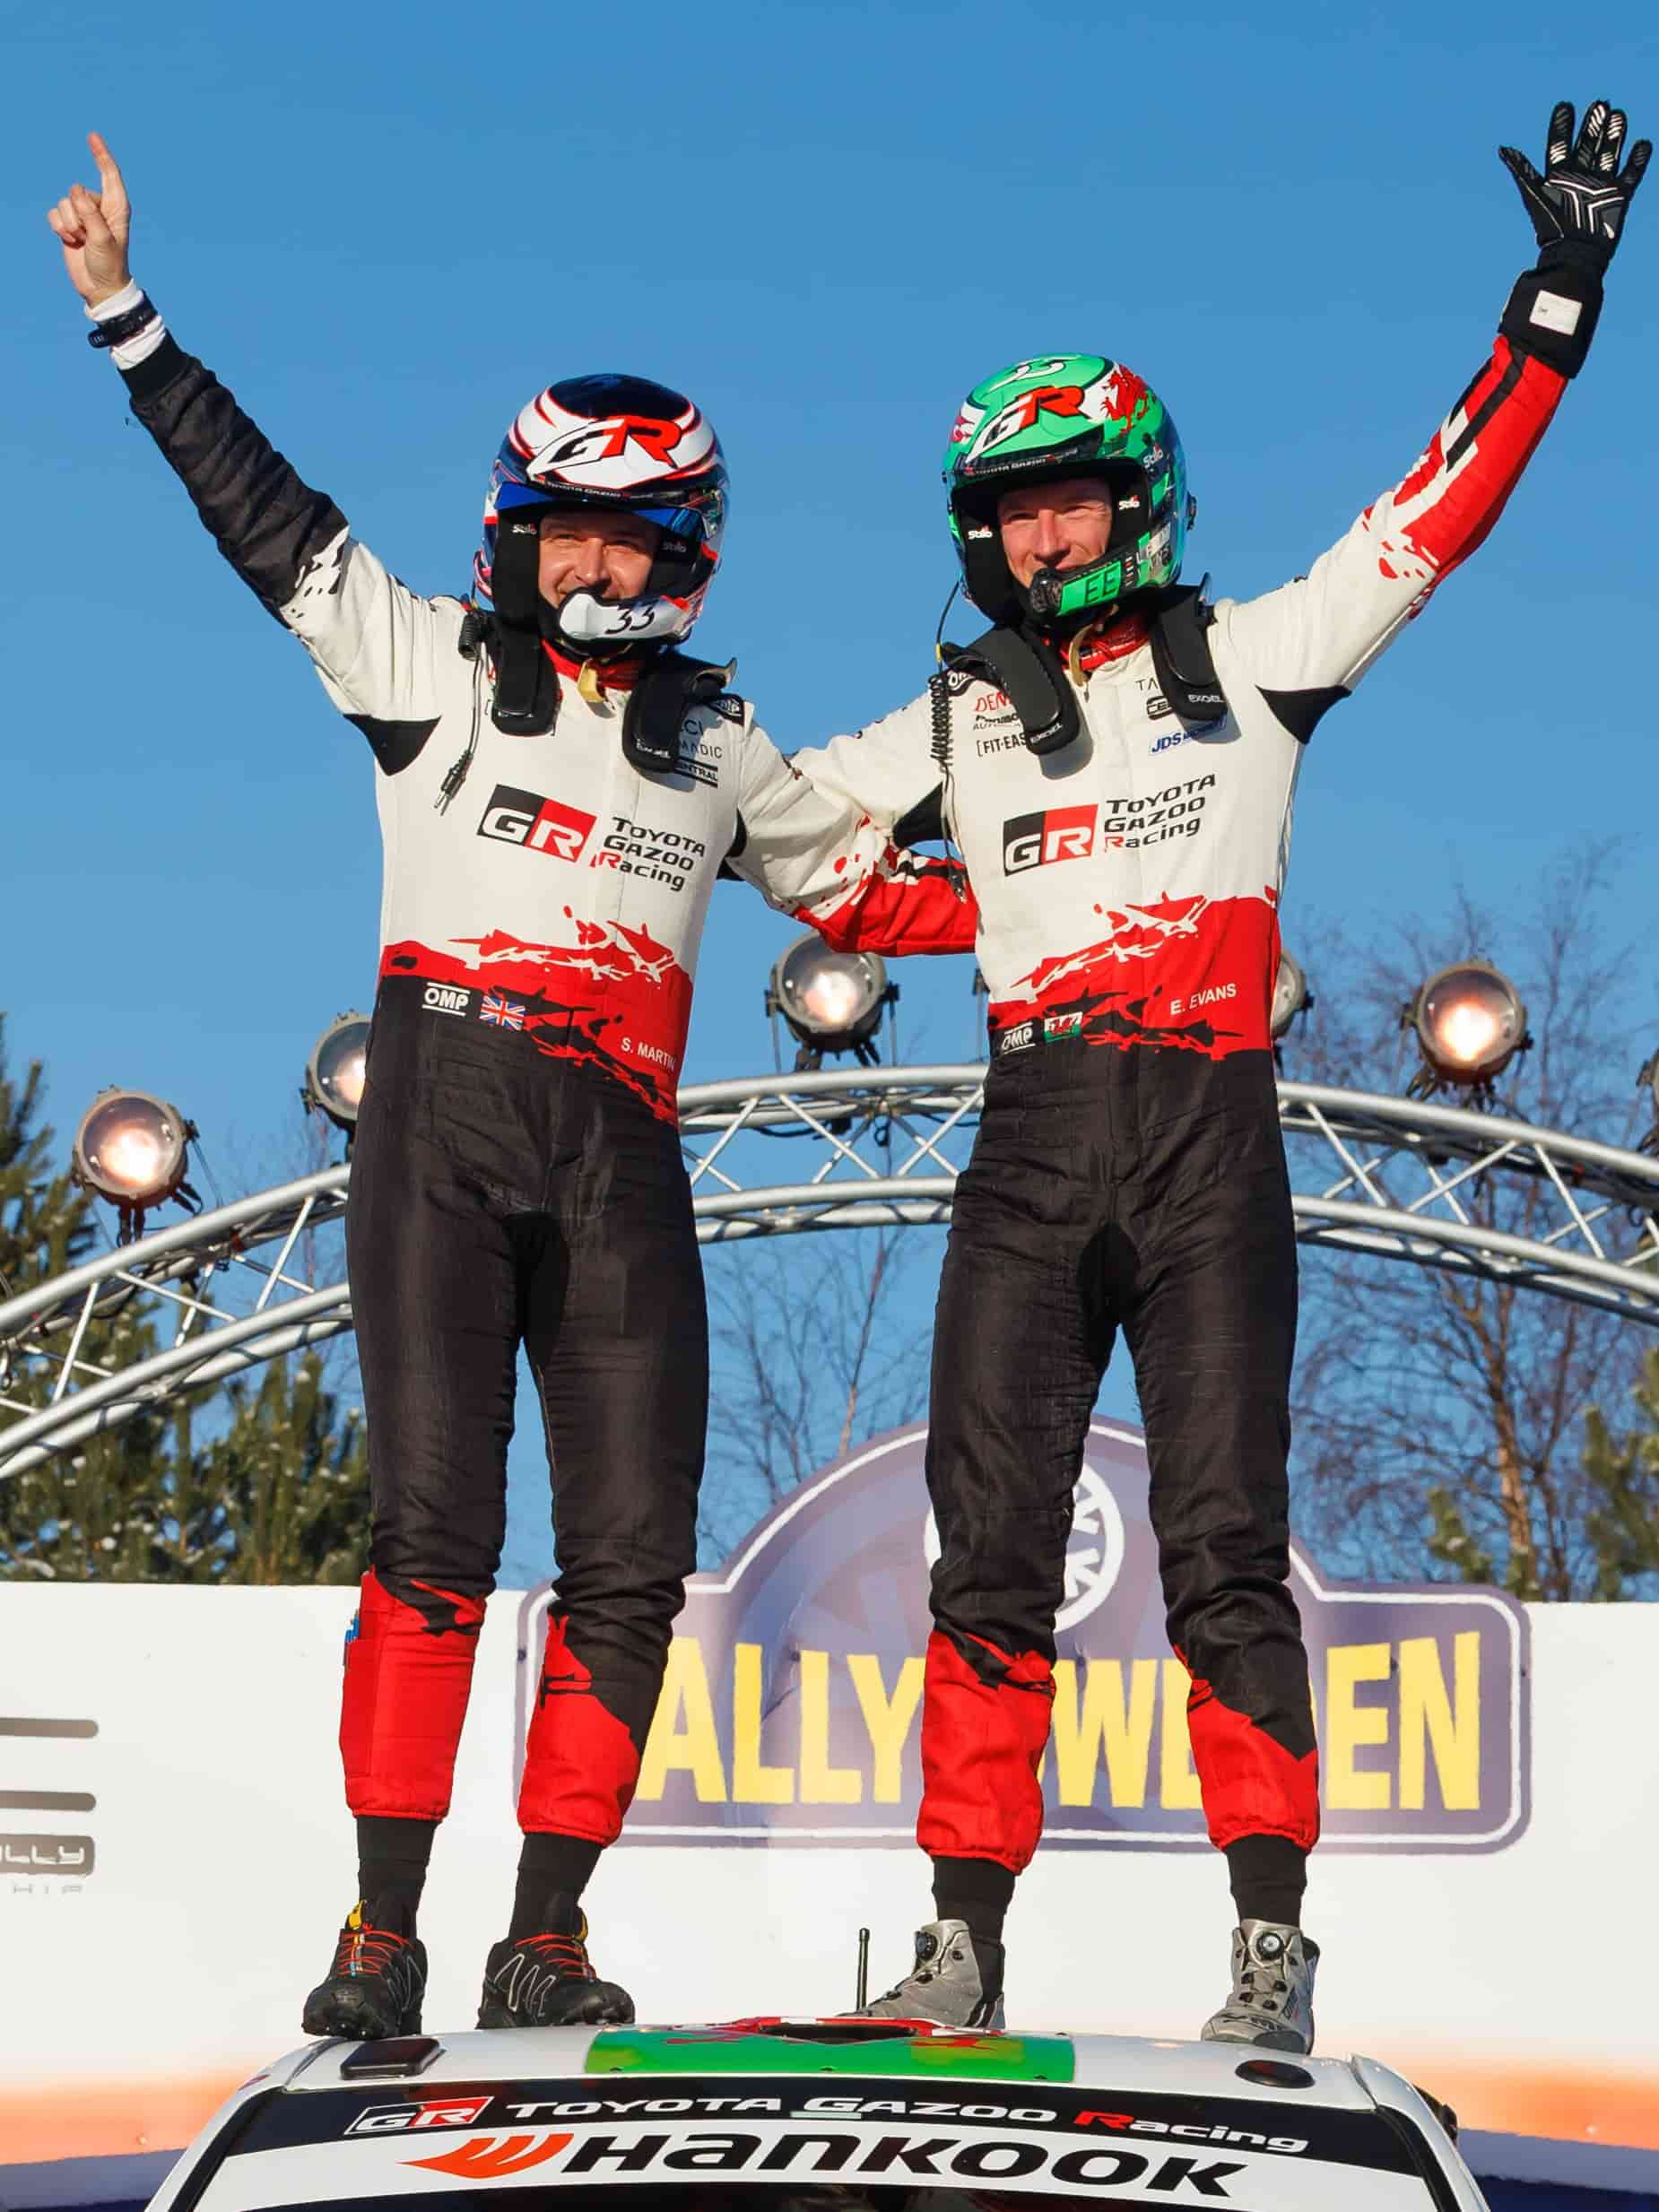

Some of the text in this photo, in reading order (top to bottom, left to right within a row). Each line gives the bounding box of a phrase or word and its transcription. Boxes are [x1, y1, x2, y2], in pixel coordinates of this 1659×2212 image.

[966, 386, 1091, 464] GR
[525, 414, 682, 481] GR
[604, 604, 656, 635] 33
[975, 691, 1008, 712] DEN
[478, 804, 706, 862] GR TOYOTA
[1003, 774, 1217, 875] GR TOYOTA
[1104, 797, 1206, 833] GAZOO
[1104, 817, 1201, 852] Racing
[589, 852, 686, 891] Racing
[603, 835, 694, 872] GAZOO
[423, 986, 470, 1011] OMP
[1189, 984, 1238, 1011] EVANS
[1000, 1028, 1033, 1052] OMP
[635, 1632, 1481, 1809] ALLY WEEN
[357, 2095, 1309, 2153] GR TOYOTA GAZOO Racing
